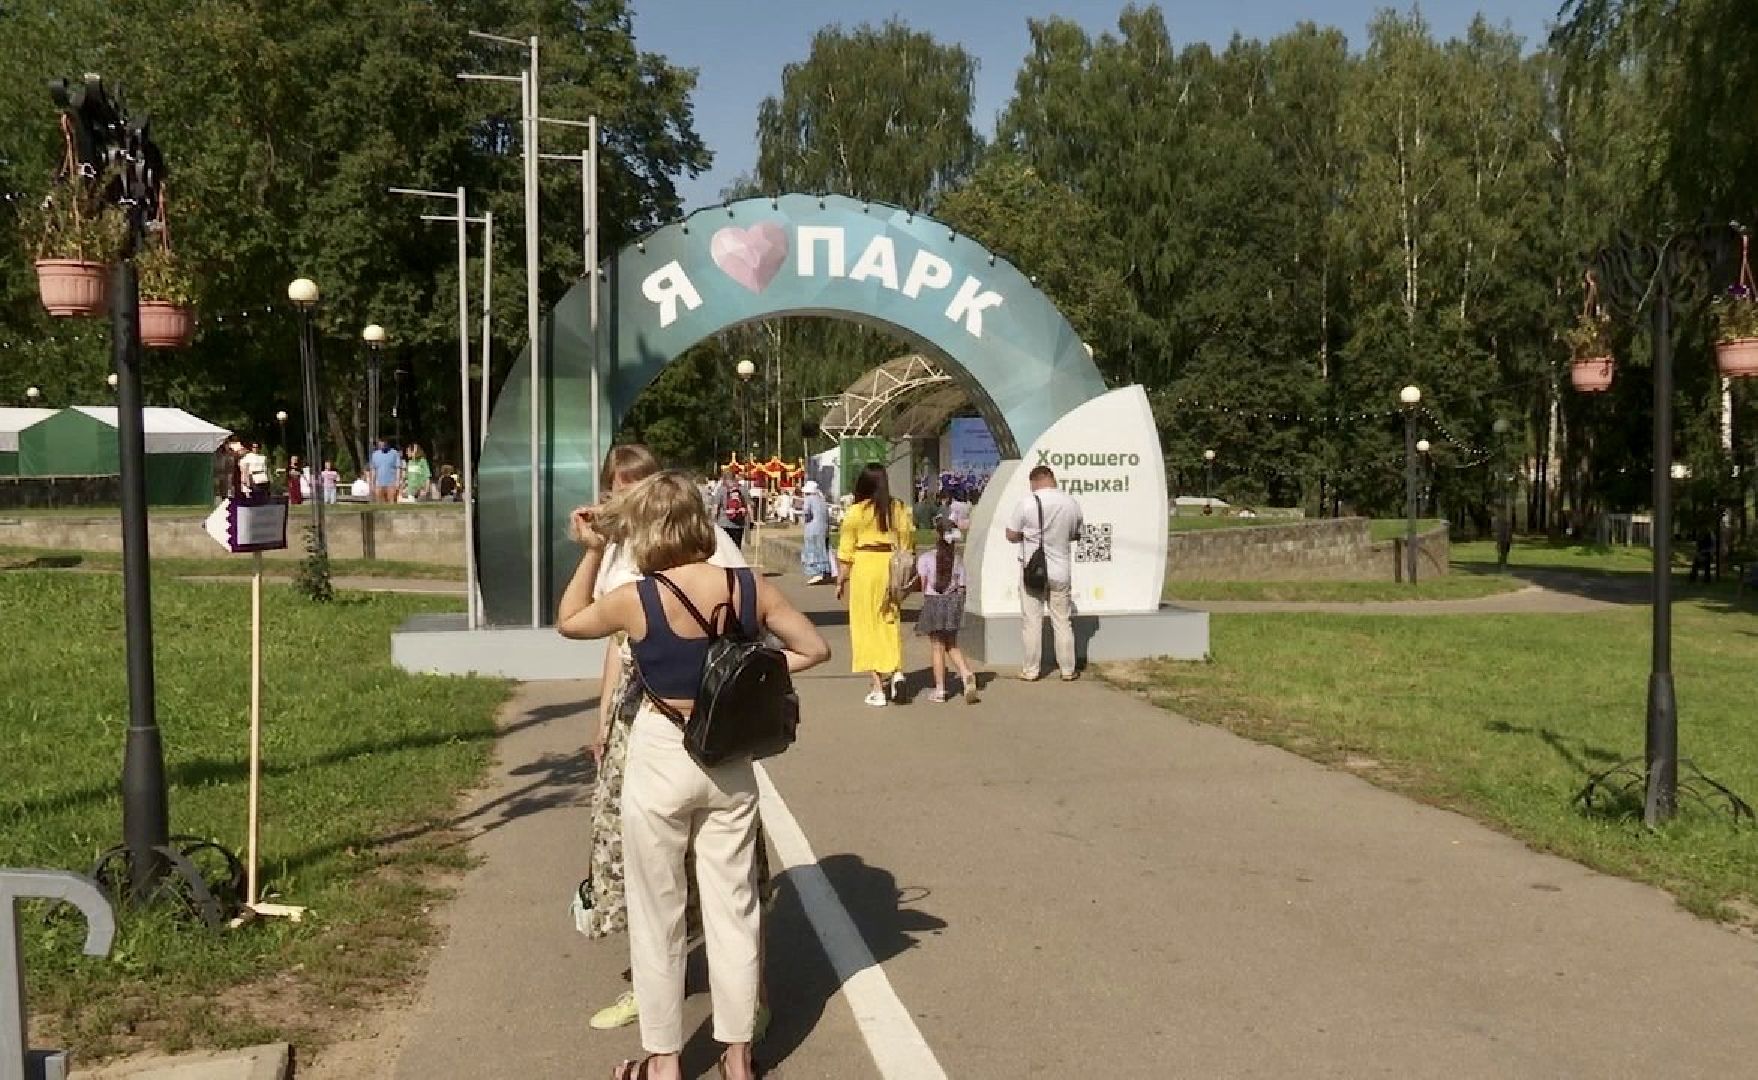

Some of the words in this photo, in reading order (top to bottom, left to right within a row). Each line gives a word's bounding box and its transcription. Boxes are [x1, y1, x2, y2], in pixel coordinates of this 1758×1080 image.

[642, 260, 703, 328] Я
[797, 225, 1003, 338] ПАРК
[1036, 449, 1140, 470] Хорошего
[1057, 475, 1129, 495] тдыха!
